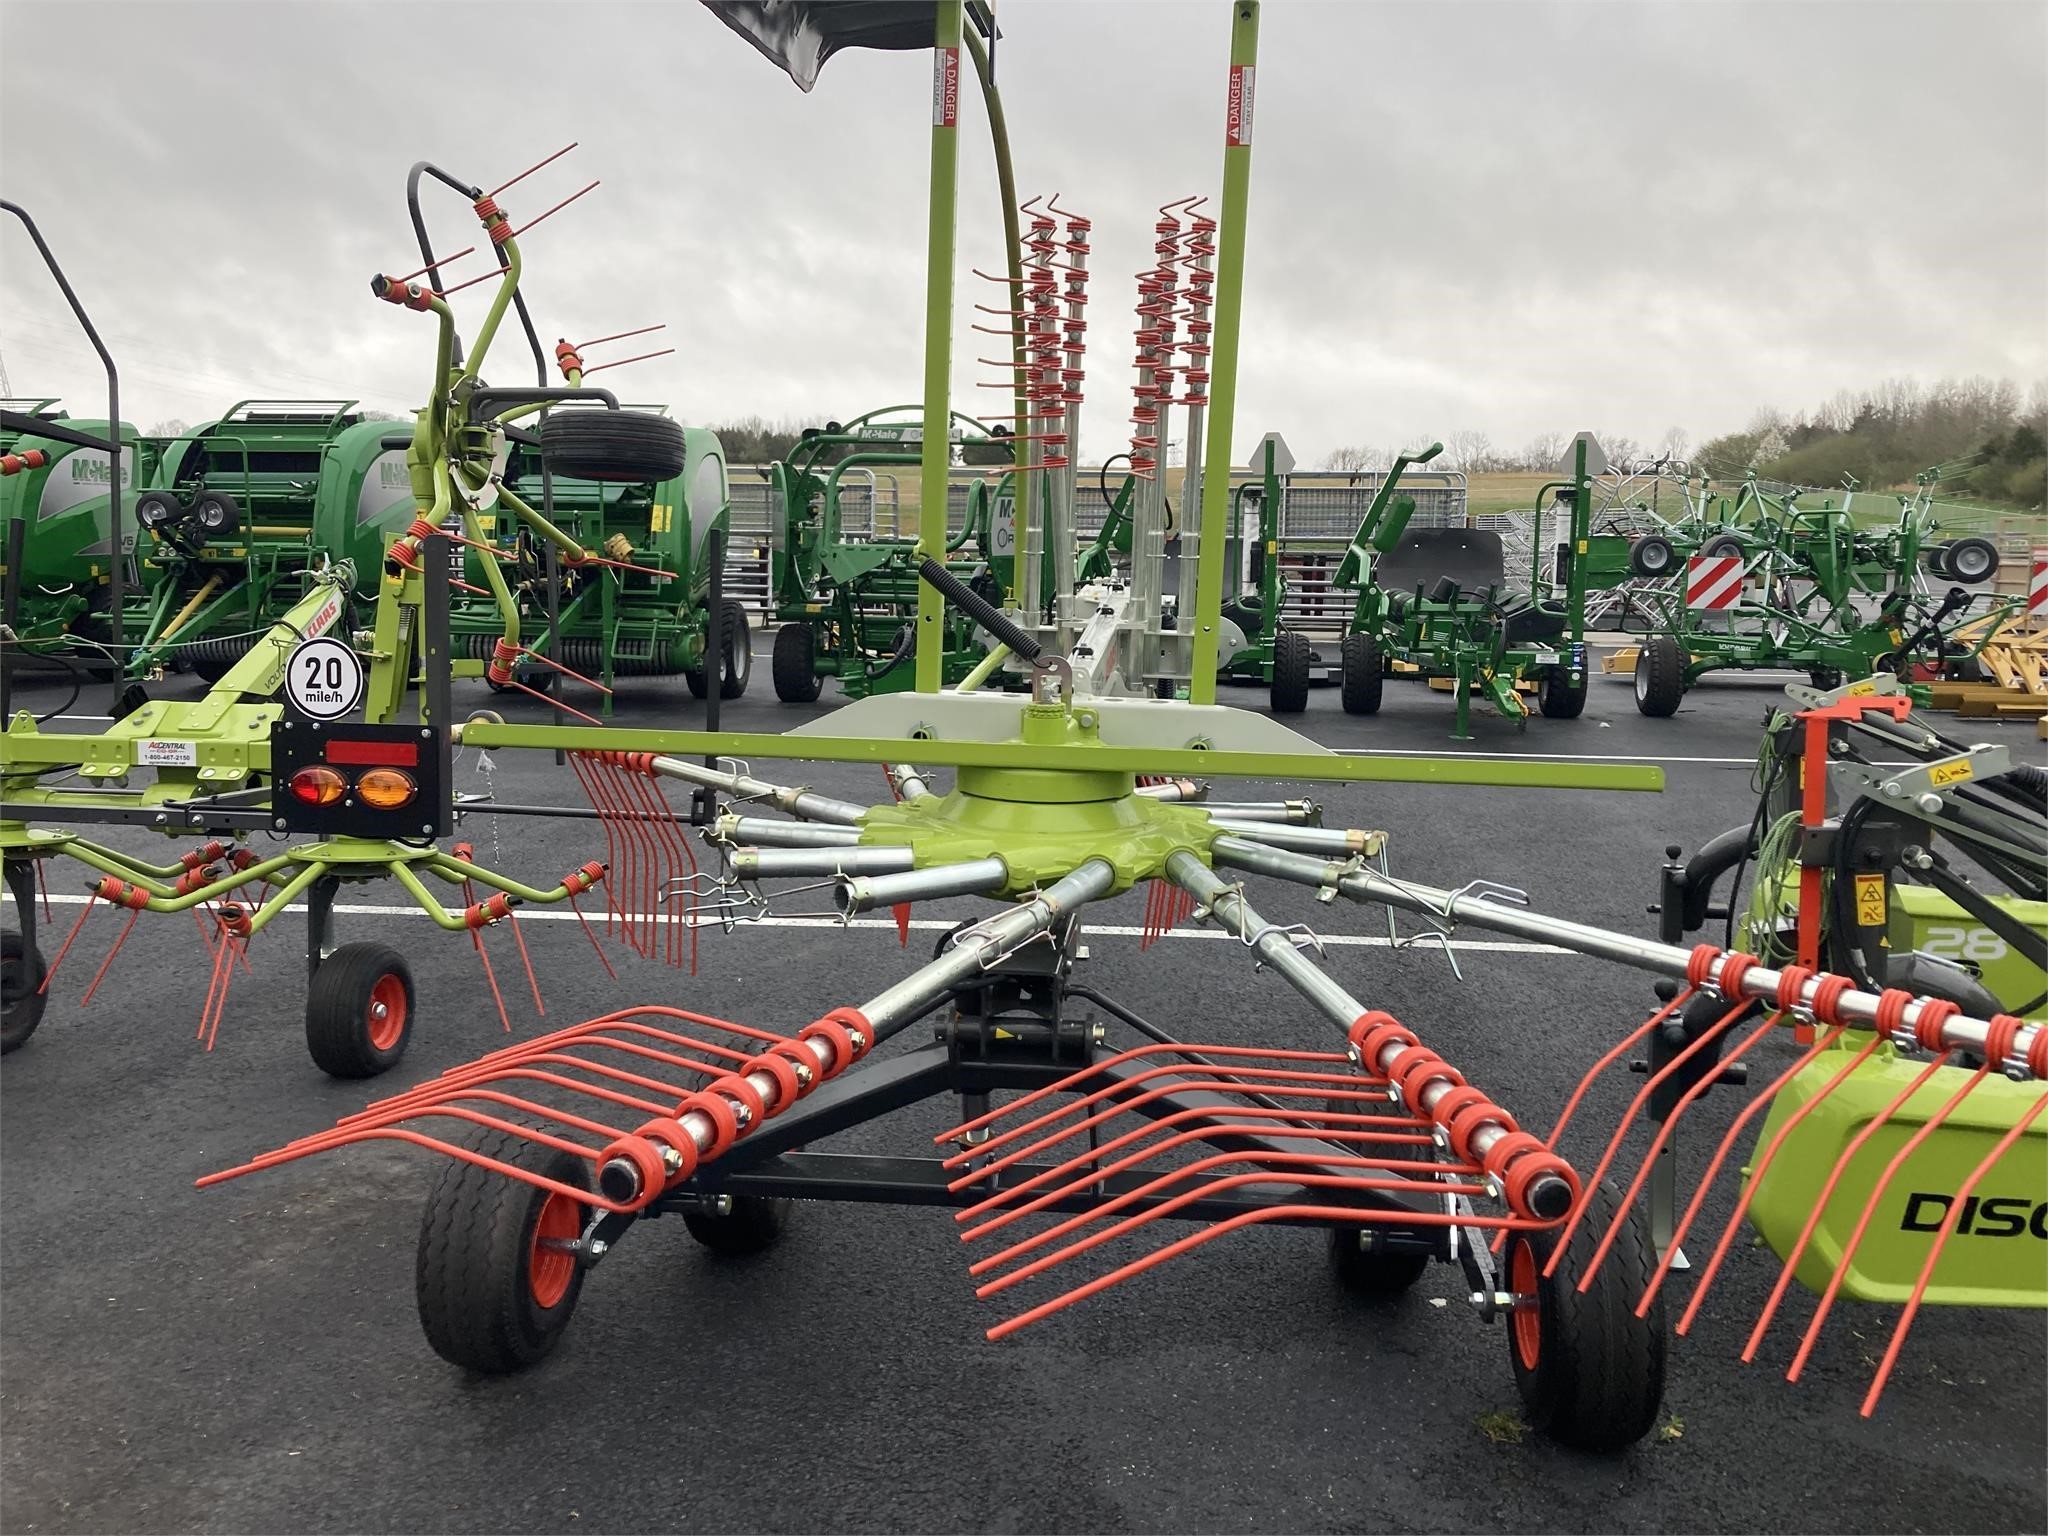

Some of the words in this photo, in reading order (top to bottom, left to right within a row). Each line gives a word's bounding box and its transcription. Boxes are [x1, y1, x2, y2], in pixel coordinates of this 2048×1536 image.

[945, 70, 956, 120] DANGER
[1229, 73, 1241, 124] DANGER
[861, 430, 898, 439] McHale
[72, 459, 128, 483] McHae
[307, 601, 337, 639] CLAAS
[305, 657, 342, 689] 20
[305, 691, 343, 703] mile/h
[1922, 927, 2007, 960] 28
